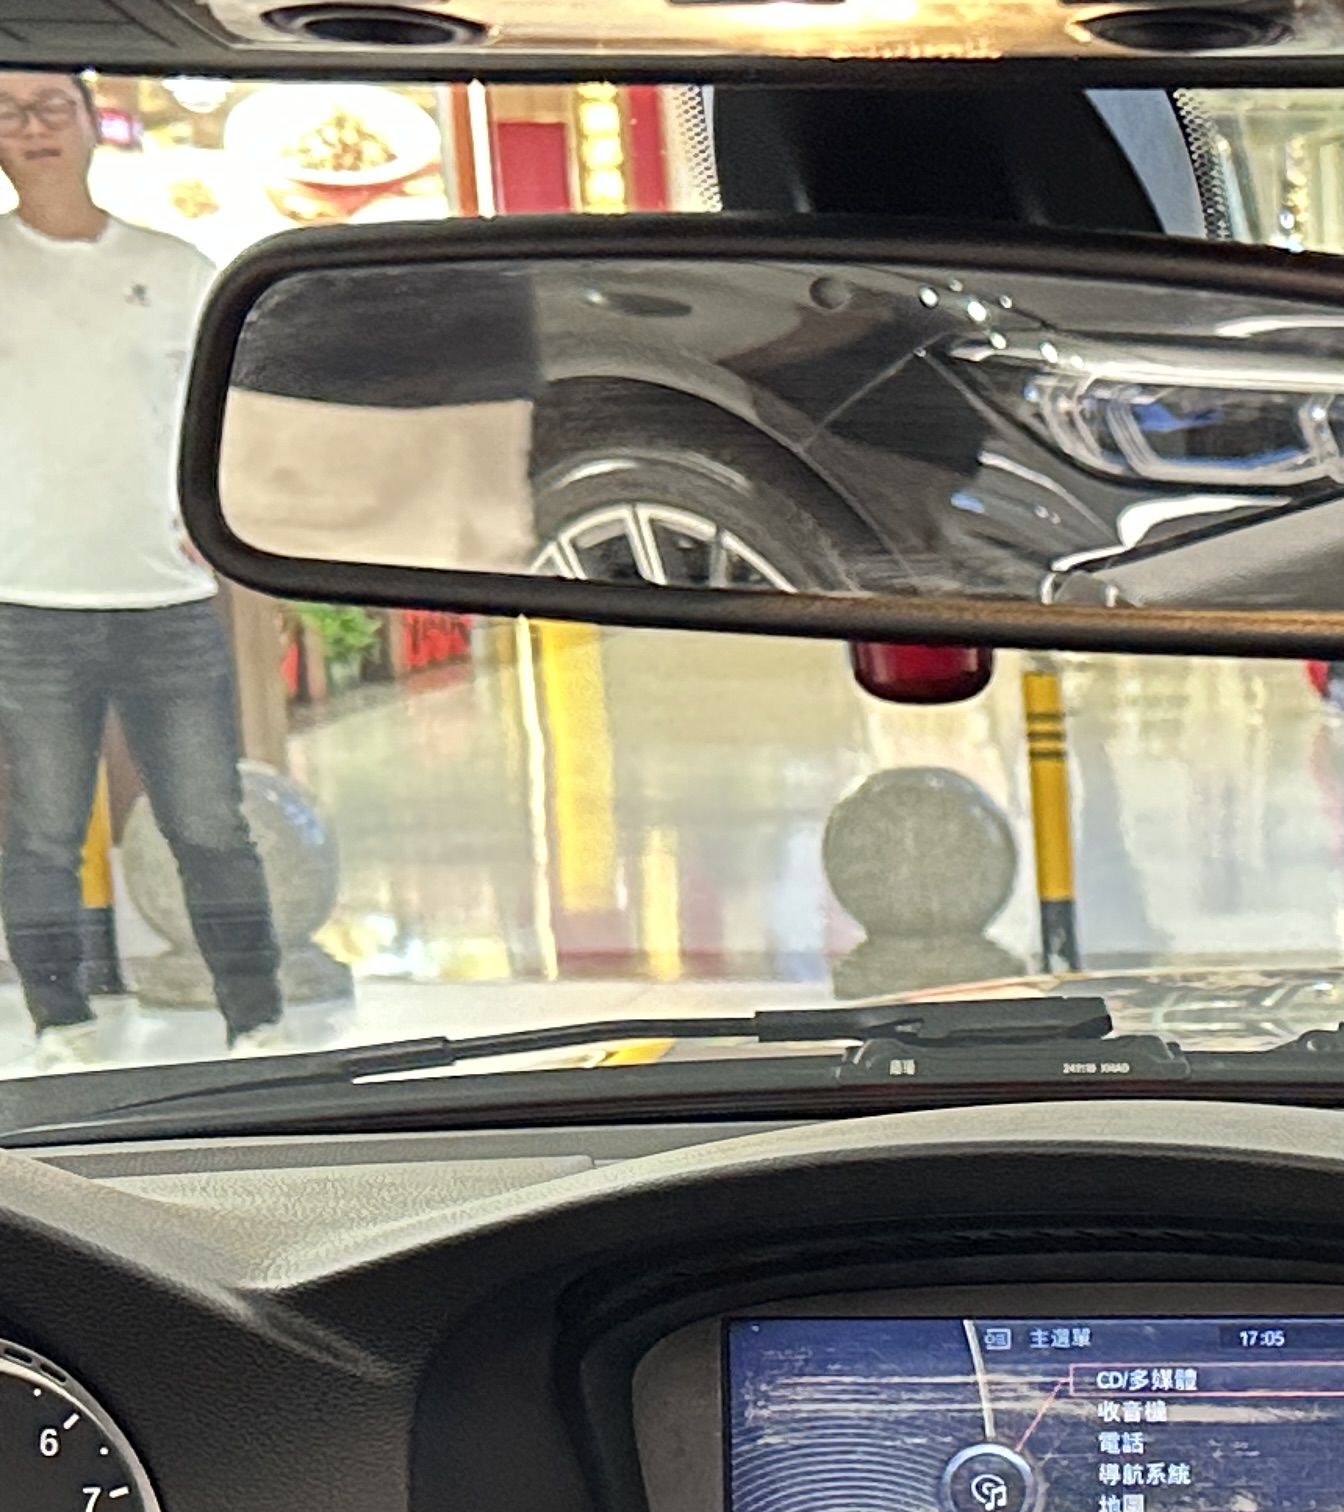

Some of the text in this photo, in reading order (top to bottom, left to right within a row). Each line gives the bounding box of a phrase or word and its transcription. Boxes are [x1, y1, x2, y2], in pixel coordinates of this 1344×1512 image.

[1029, 1328, 1092, 1348] 主選單
[1238, 1330, 1285, 1347] 17:05
[1096, 1368, 1198, 1391] CD/多媒體
[1098, 1400, 1168, 1422] 收音機
[40, 1428, 59, 1457] 6
[1098, 1431, 1145, 1454] 電話
[1098, 1462, 1192, 1486] 導航系統
